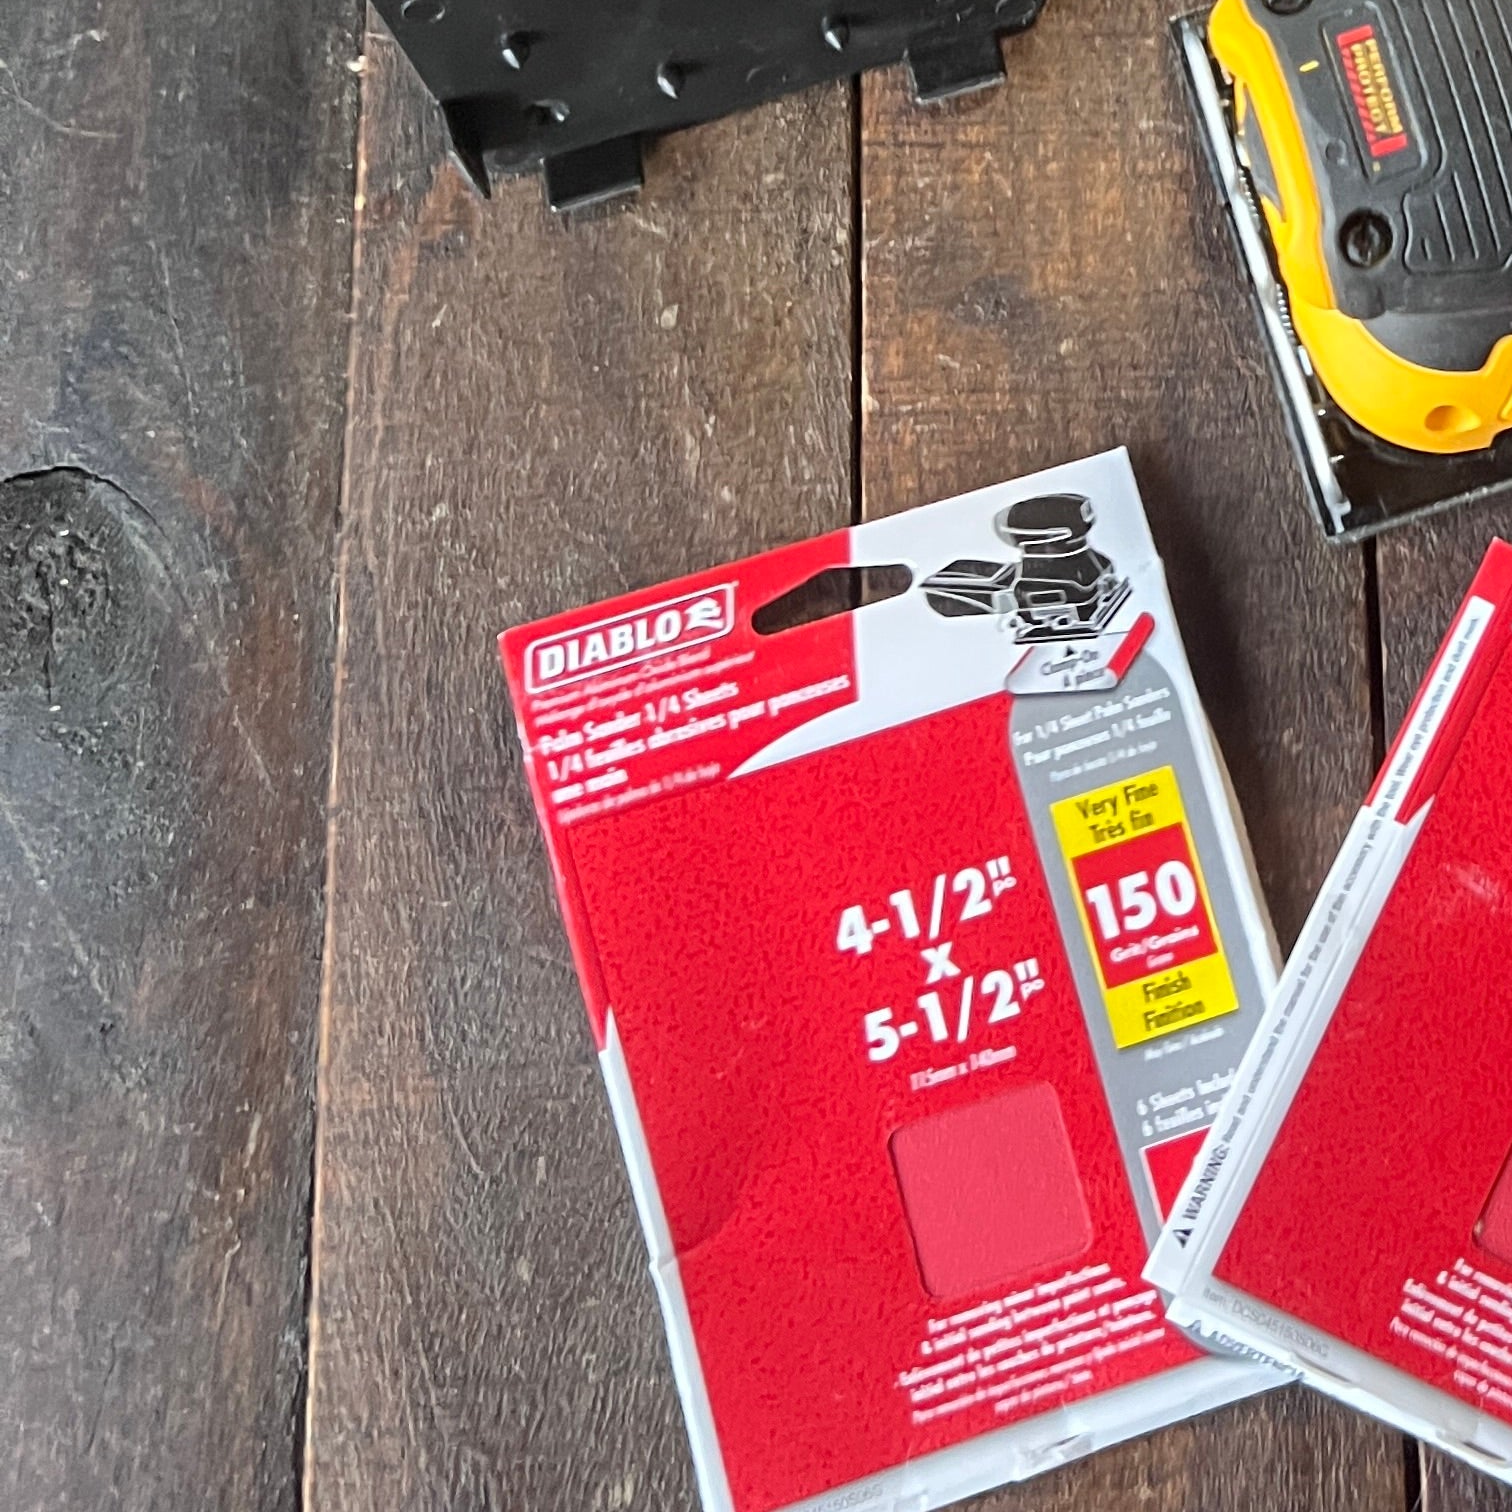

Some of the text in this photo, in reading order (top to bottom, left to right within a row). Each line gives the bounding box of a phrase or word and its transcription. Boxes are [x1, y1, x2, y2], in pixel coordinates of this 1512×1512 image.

[538, 609, 681, 680] DIABLO
[1075, 783, 1159, 819] Very Fine
[1129, 809, 1154, 831] fin
[1085, 860, 1197, 940] 150
[1141, 970, 1192, 1003] Finish
[1141, 1000, 1205, 1032] Finition
[1181, 1144, 1230, 1220] WARNING:
